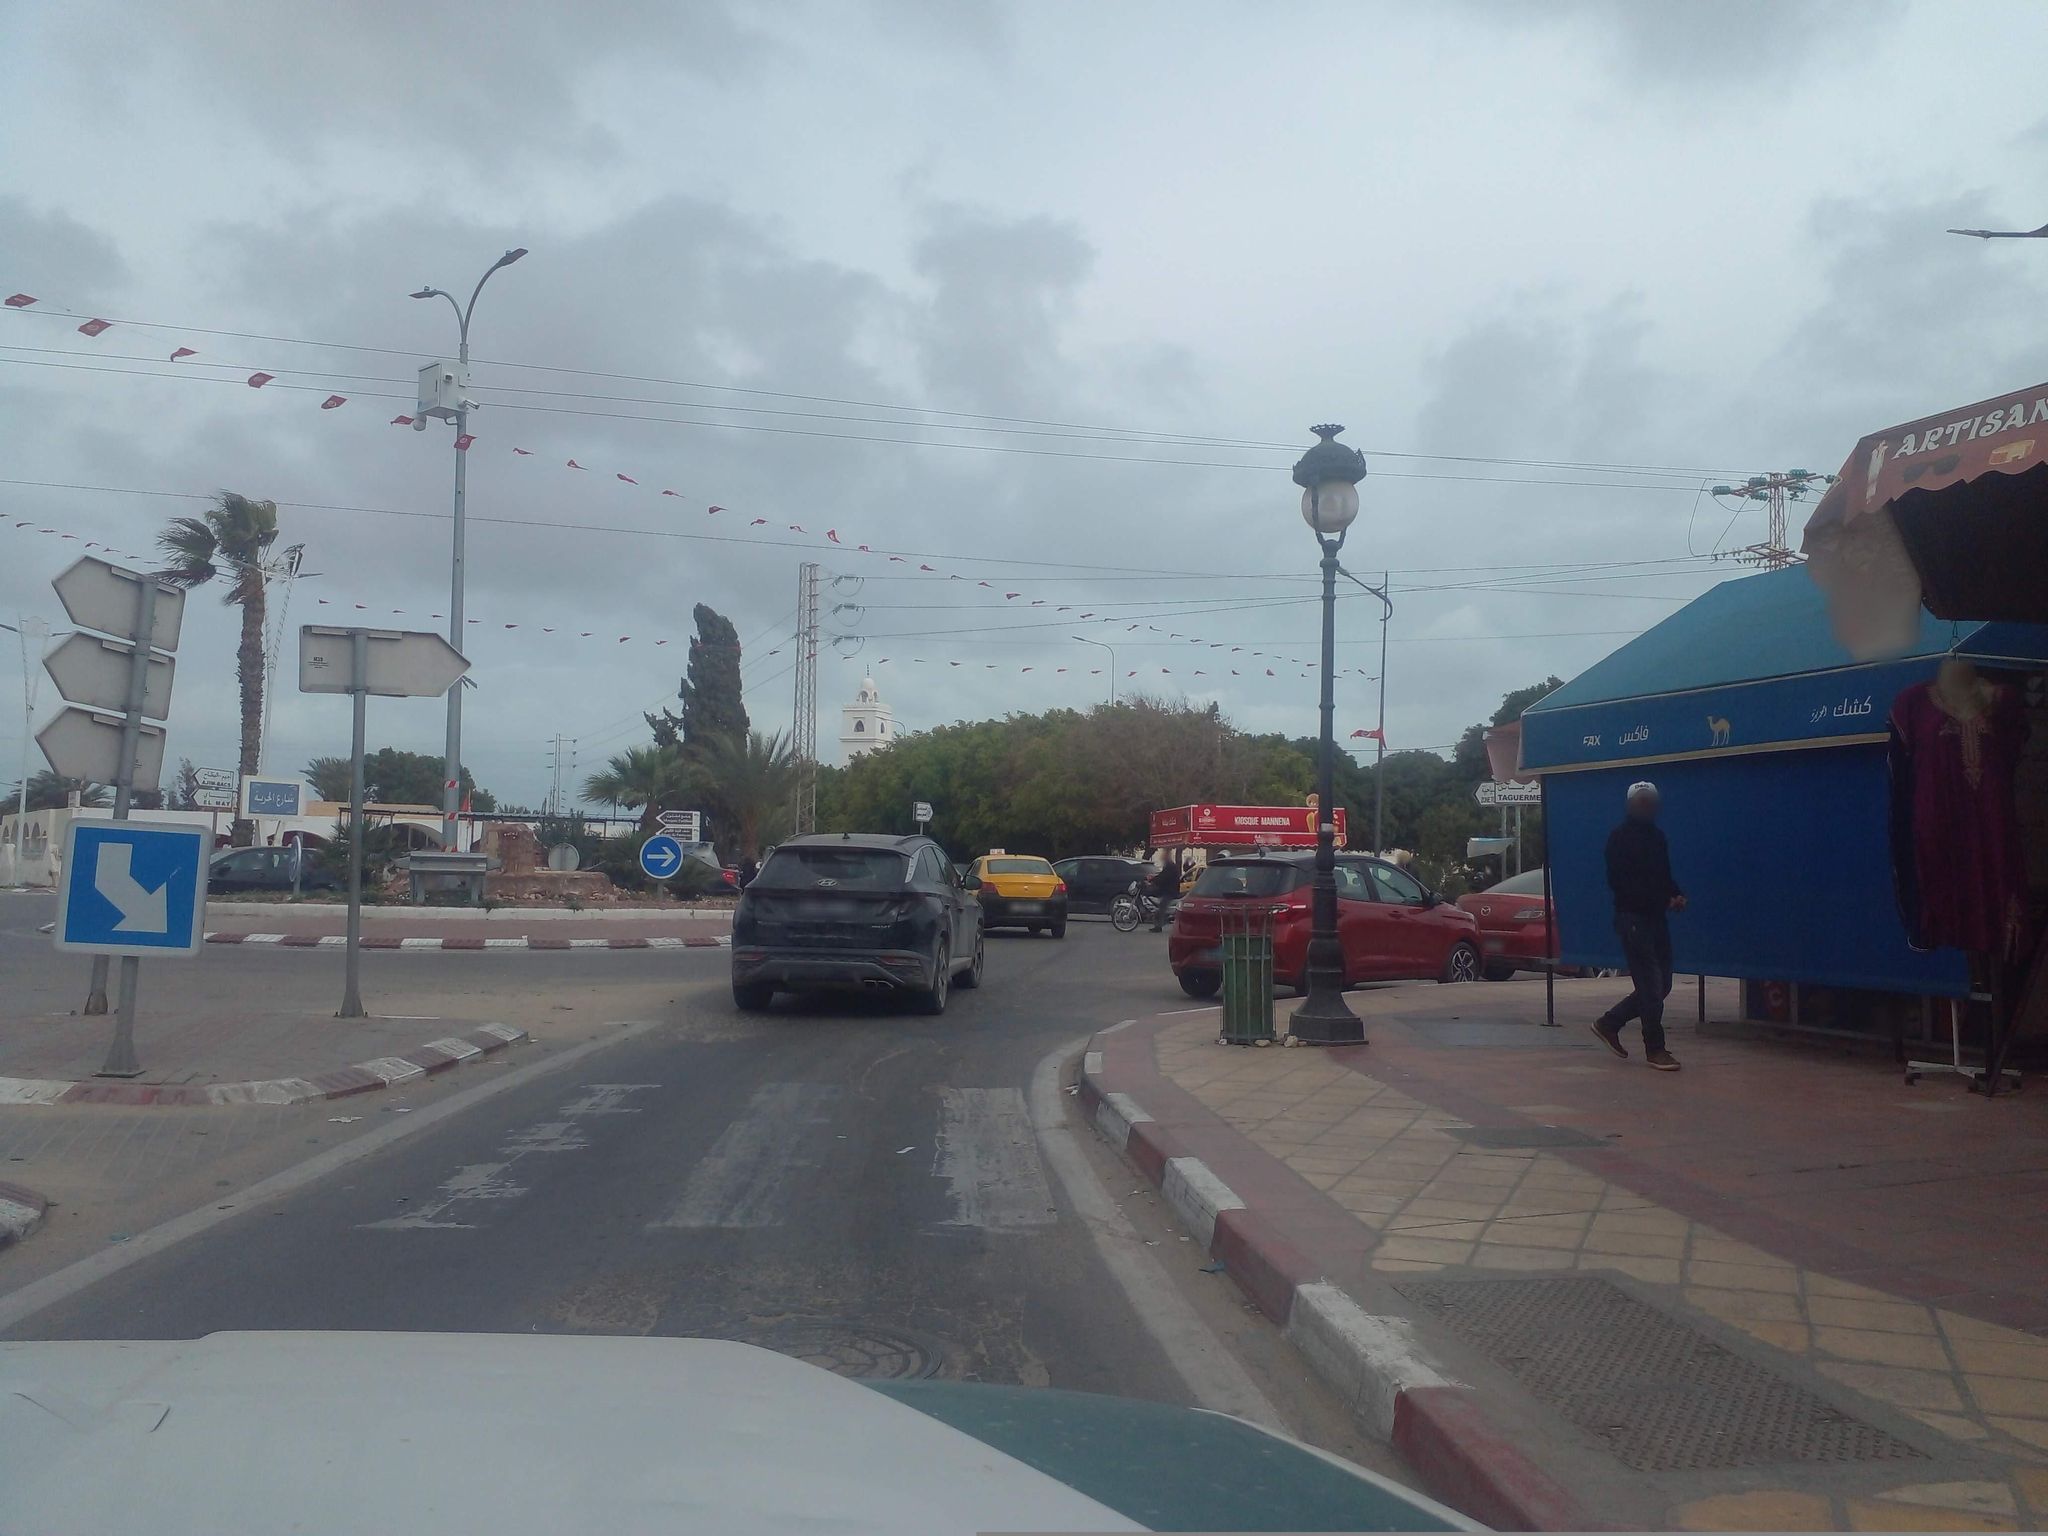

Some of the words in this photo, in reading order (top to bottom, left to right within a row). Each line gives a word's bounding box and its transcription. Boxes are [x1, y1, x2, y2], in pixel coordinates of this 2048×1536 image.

[1833, 695, 1871, 717] كشك
[1583, 735, 1600, 746] FAX
[1618, 725, 1649, 745] فاكس
[254, 790, 275, 805] الحرية
[276, 793, 295, 807] شارع
[1234, 816, 1259, 825] KIOSQUE
